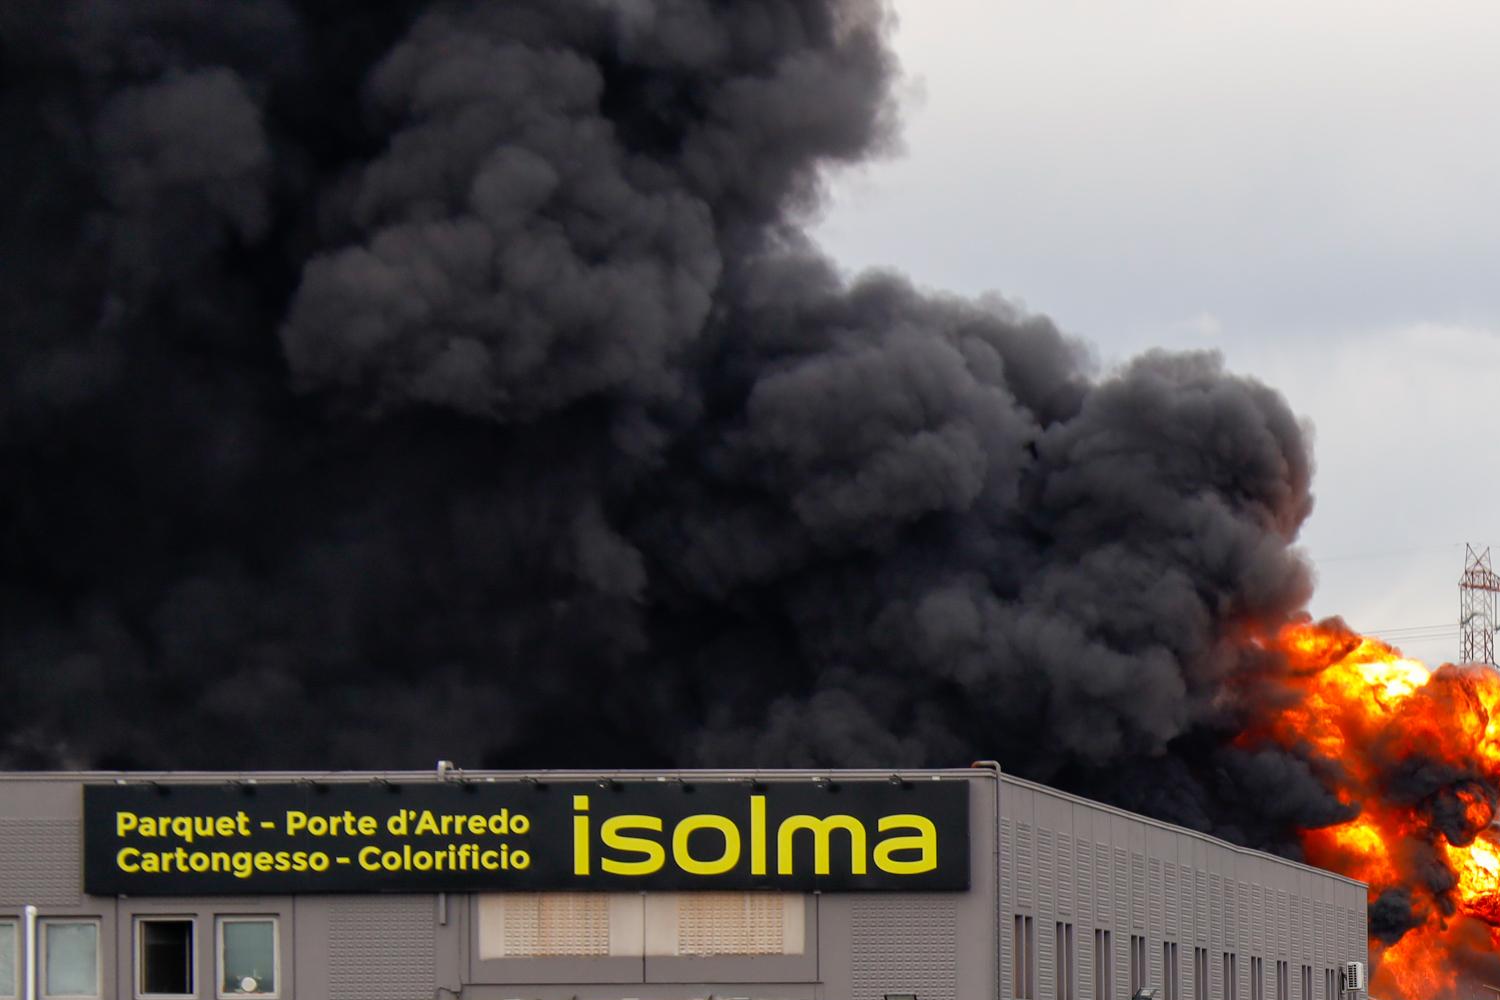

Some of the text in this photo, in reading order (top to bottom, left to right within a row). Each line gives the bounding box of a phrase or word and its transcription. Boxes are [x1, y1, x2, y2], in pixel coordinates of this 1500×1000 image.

[116, 810, 251, 843] Parquet
[286, 810, 378, 837] Porte
[573, 795, 937, 875] isolma
[116, 847, 330, 879] Cartongesso
[358, 843, 531, 872] Colorificio
